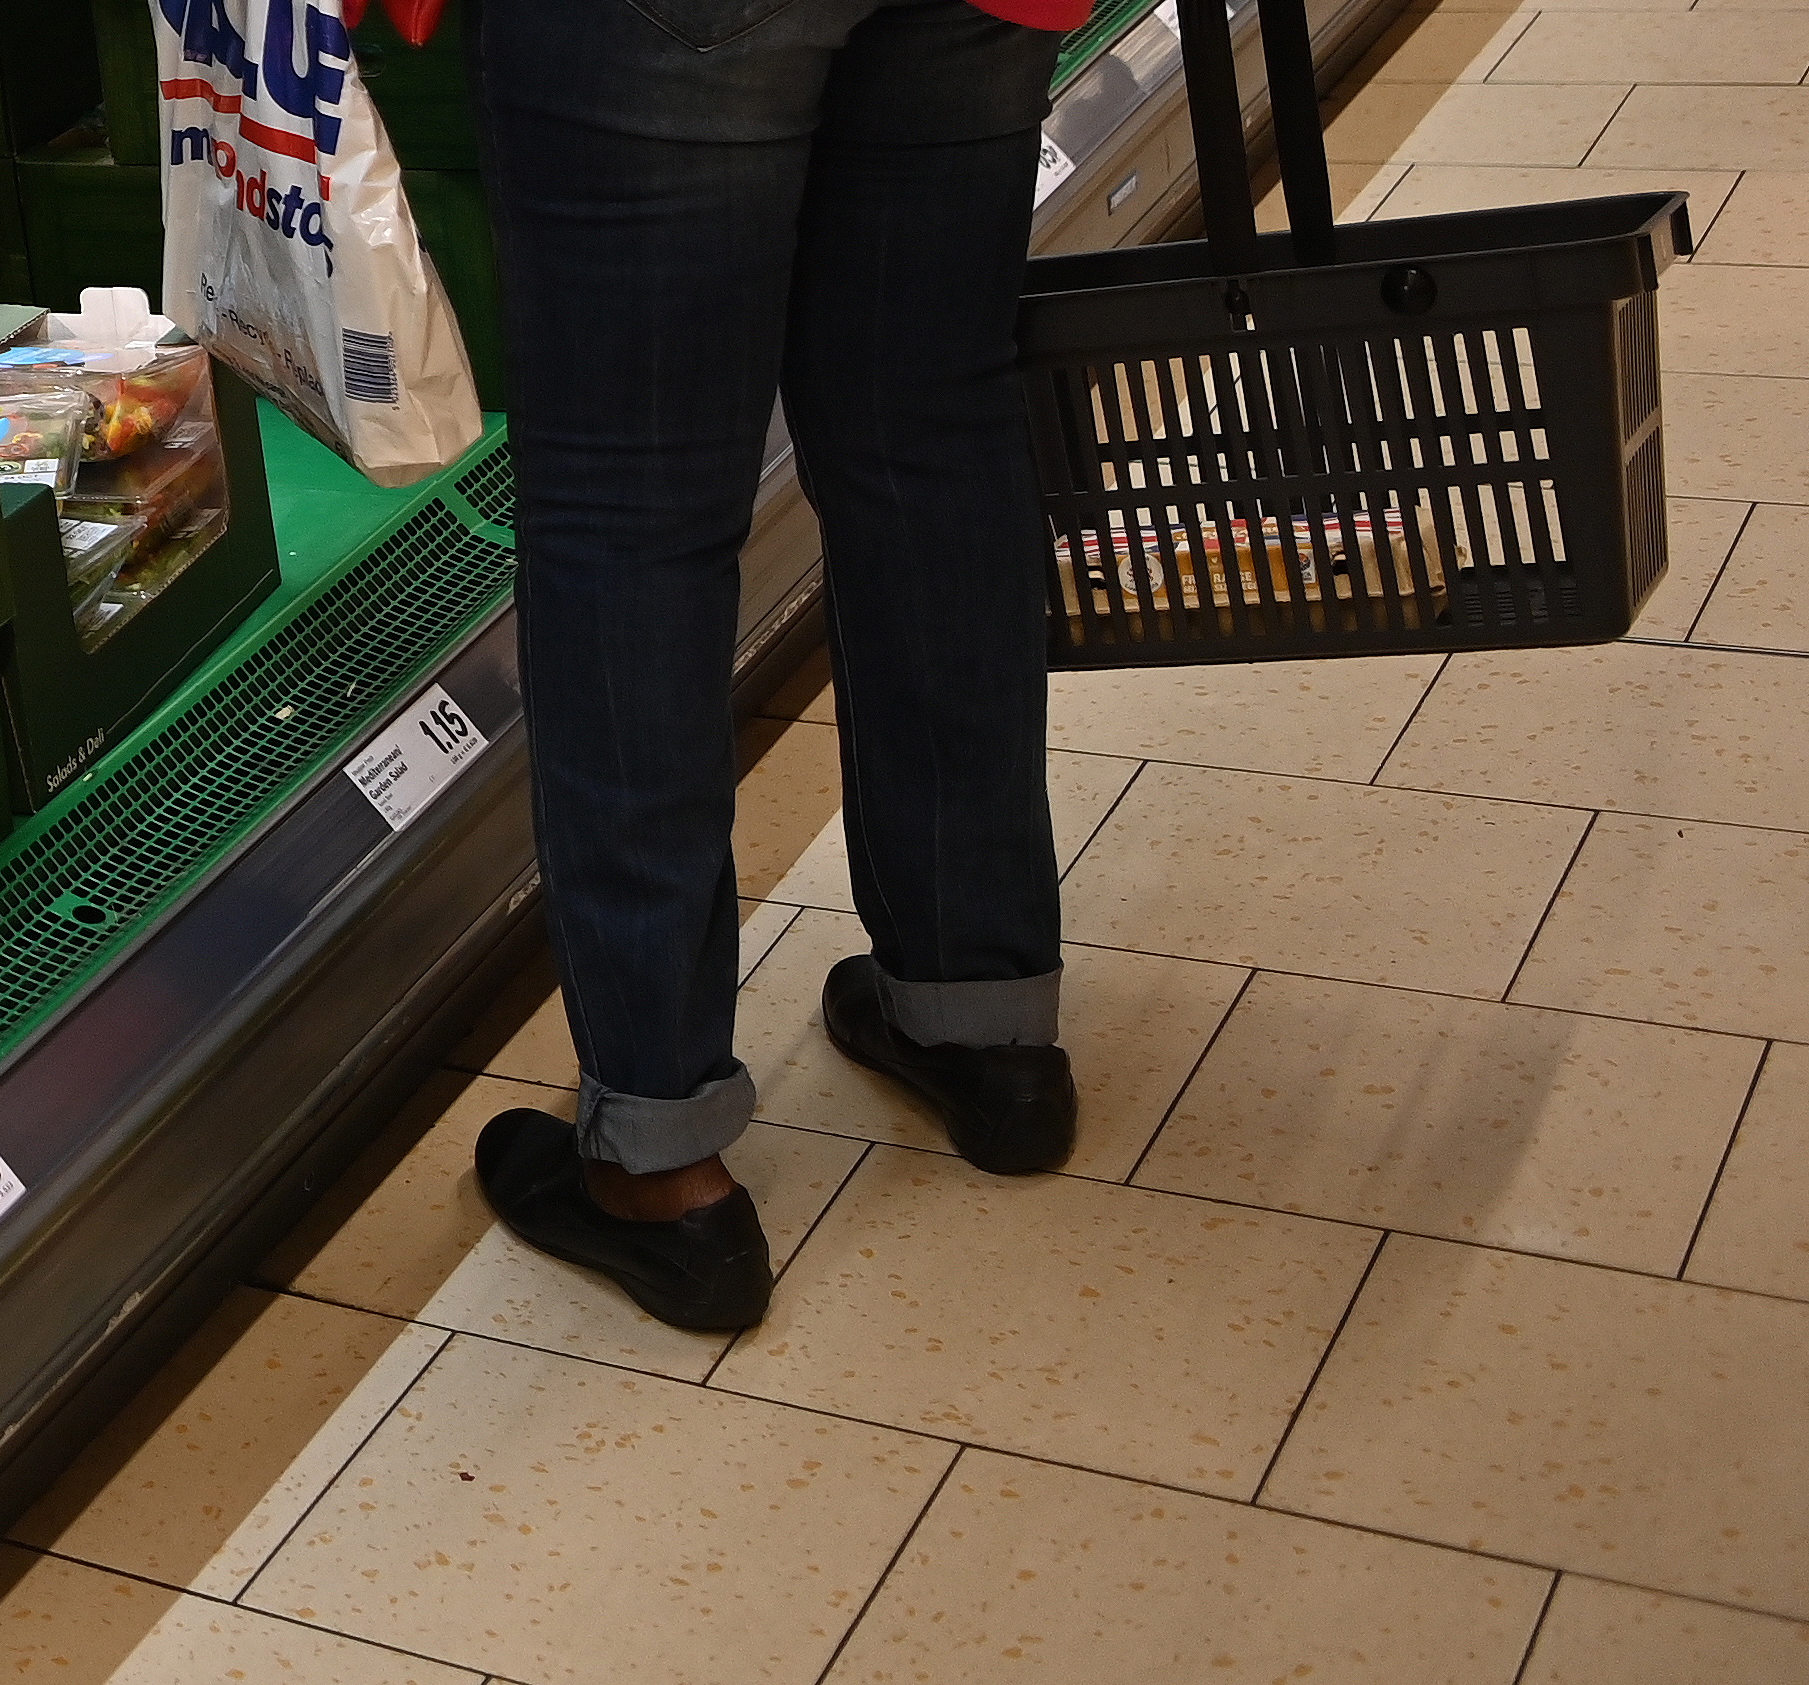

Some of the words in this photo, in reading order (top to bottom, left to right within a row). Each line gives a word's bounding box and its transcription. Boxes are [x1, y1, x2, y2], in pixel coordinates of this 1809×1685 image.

[418, 699, 470, 757] 1.15
[45, 758, 79, 794] Salads
[87, 727, 105, 756] Deli
